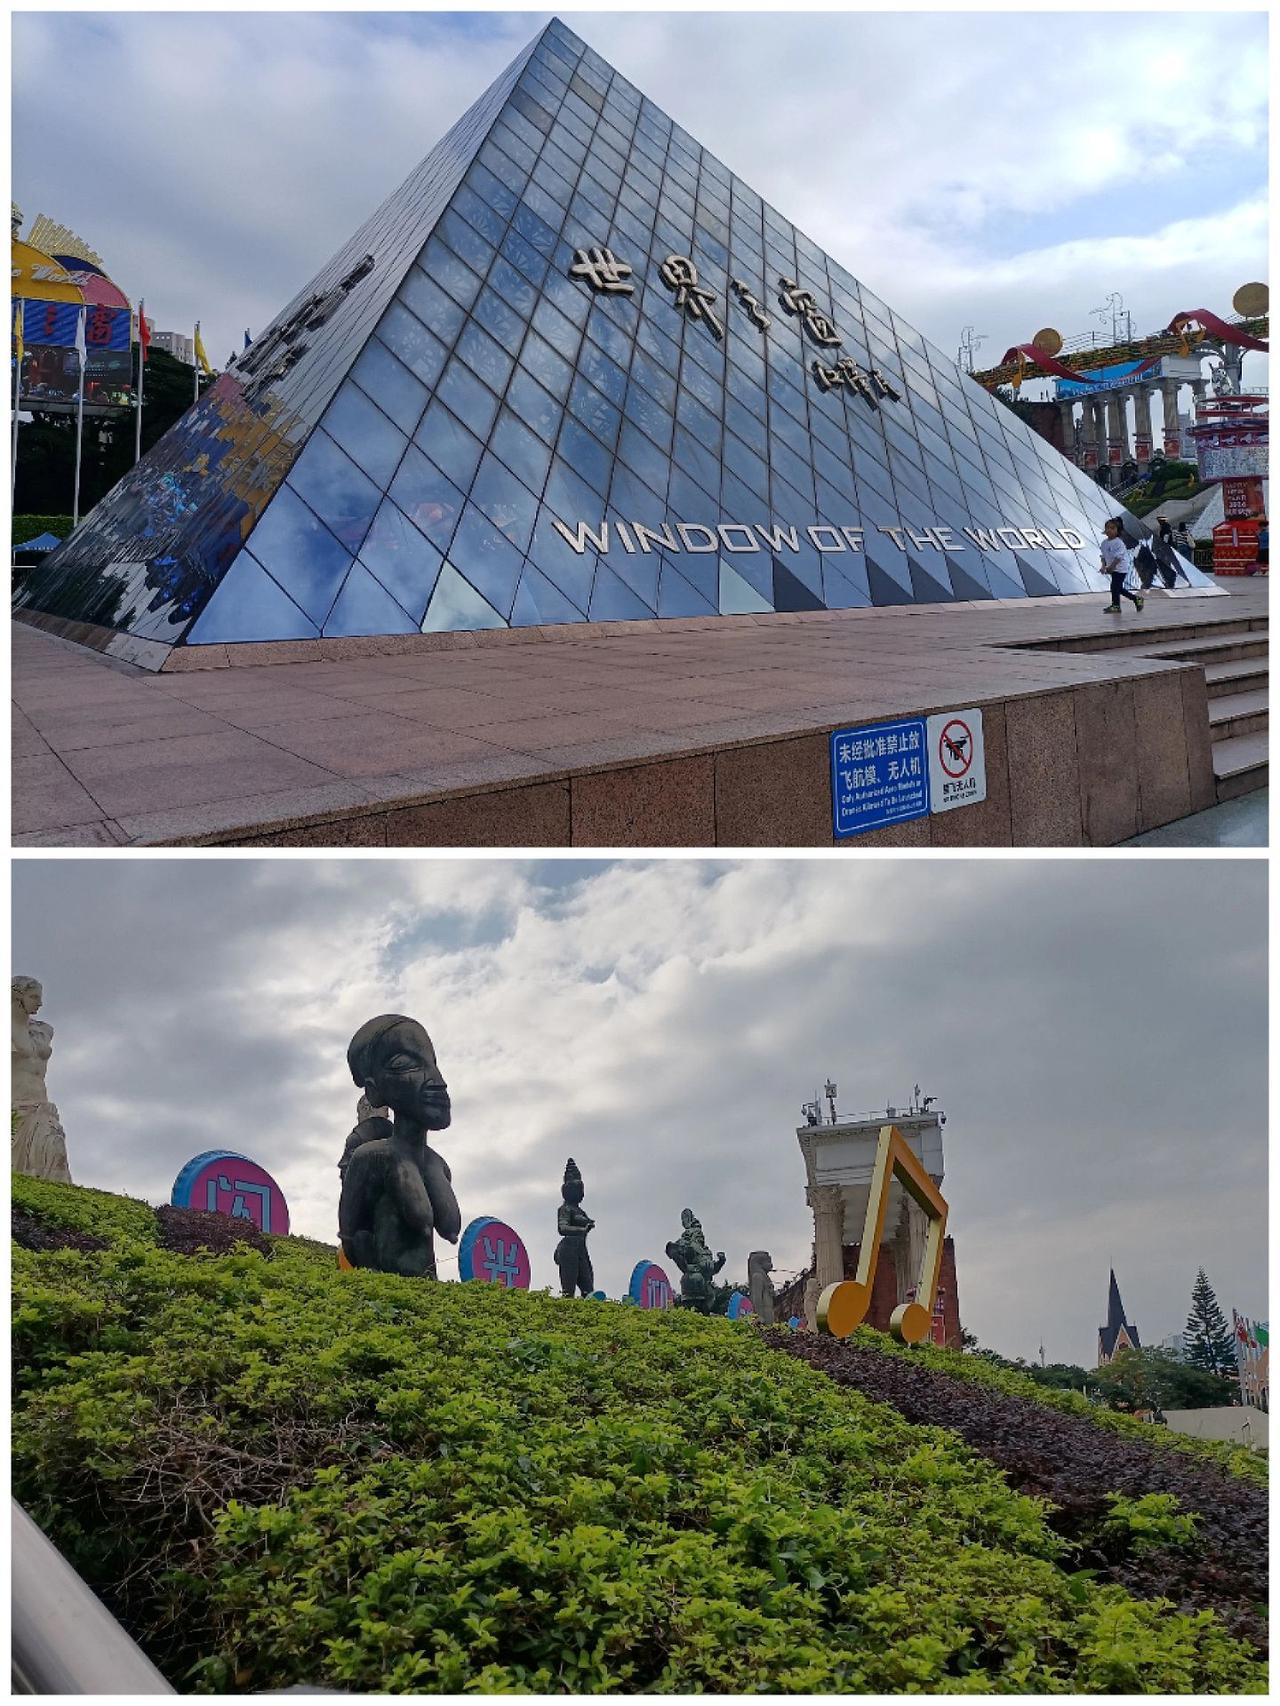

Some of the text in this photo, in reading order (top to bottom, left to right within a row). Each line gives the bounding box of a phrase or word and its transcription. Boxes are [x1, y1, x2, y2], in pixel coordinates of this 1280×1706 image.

[570, 247, 842, 349] 世界之窗
[552, 520, 1088, 555] WINDOW OF THE WORLD
[839, 730, 920, 764] 未经批准禁止放
